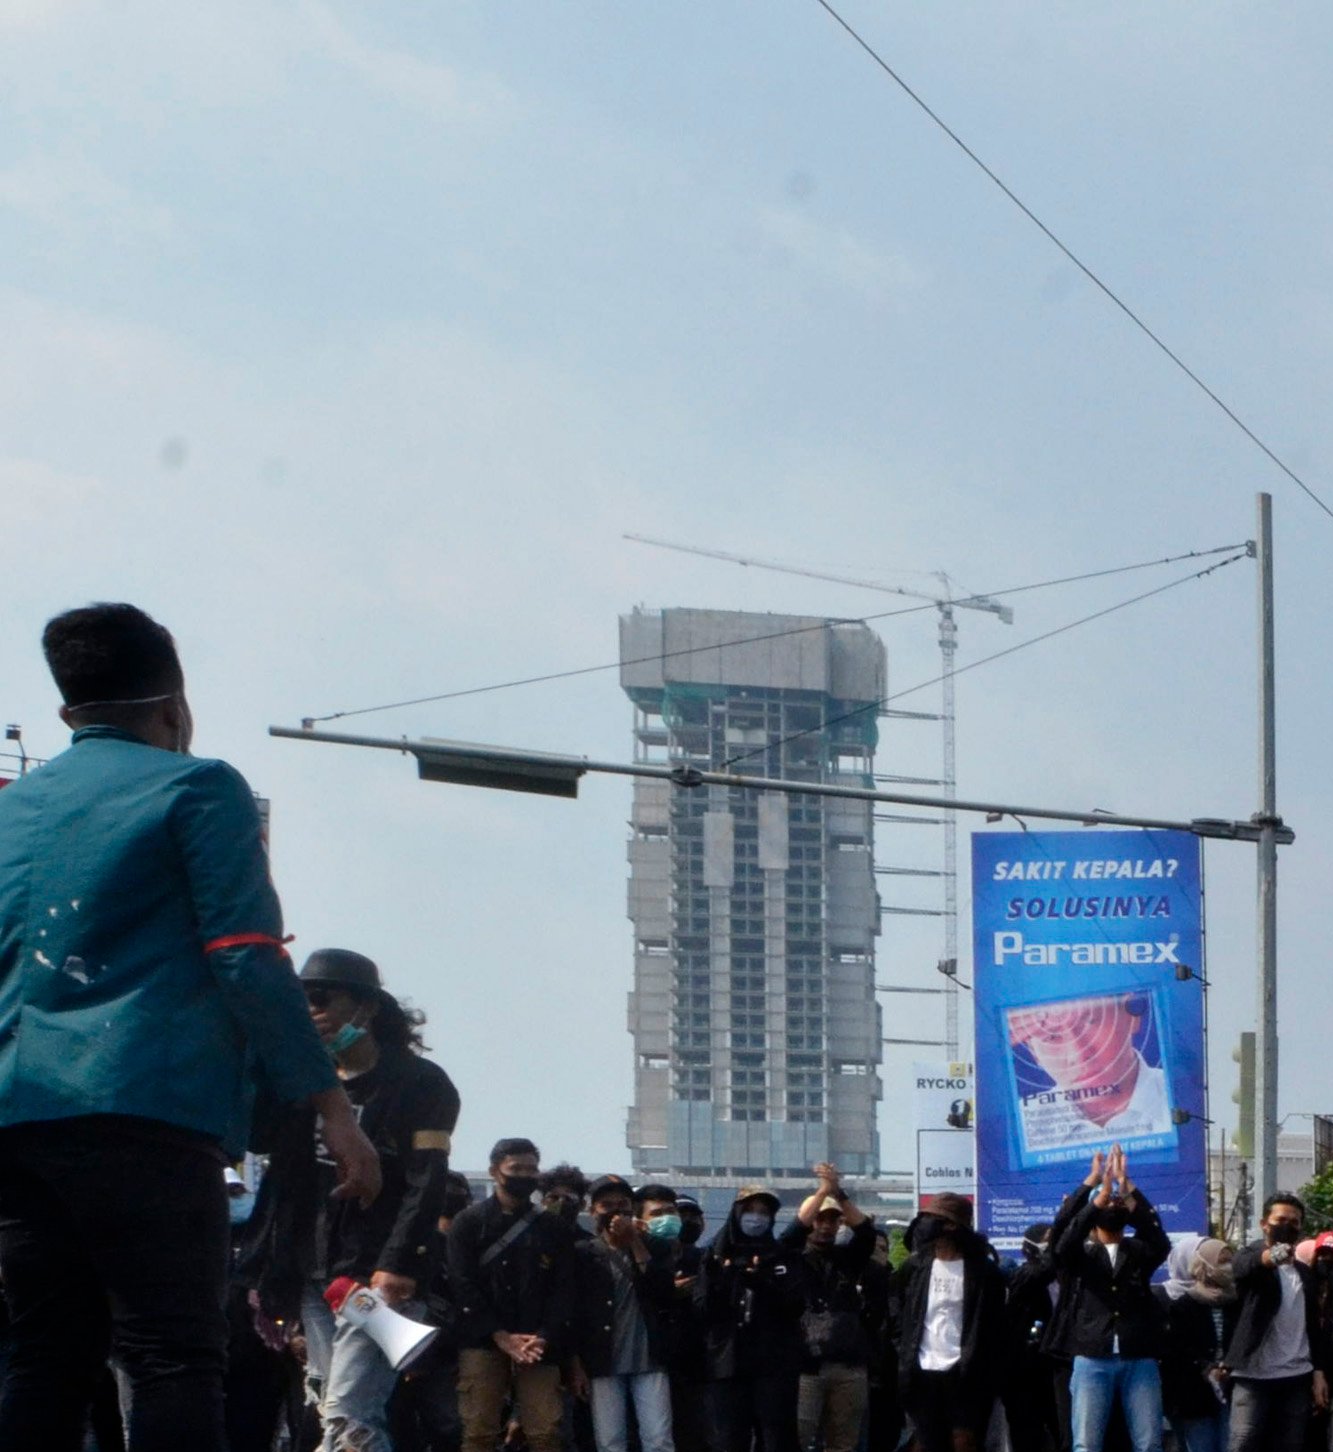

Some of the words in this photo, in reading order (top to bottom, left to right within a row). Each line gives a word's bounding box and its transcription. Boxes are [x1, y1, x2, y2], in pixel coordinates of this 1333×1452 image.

[993, 860, 1067, 881] SAKIT
[1072, 857, 1179, 881] KEPALA?
[1006, 895, 1172, 922] SOLUSINYA
[993, 930, 1180, 966] Paramex
[916, 1078, 966, 1090] RYCKO
[1023, 1084, 1121, 1107] Paramex
